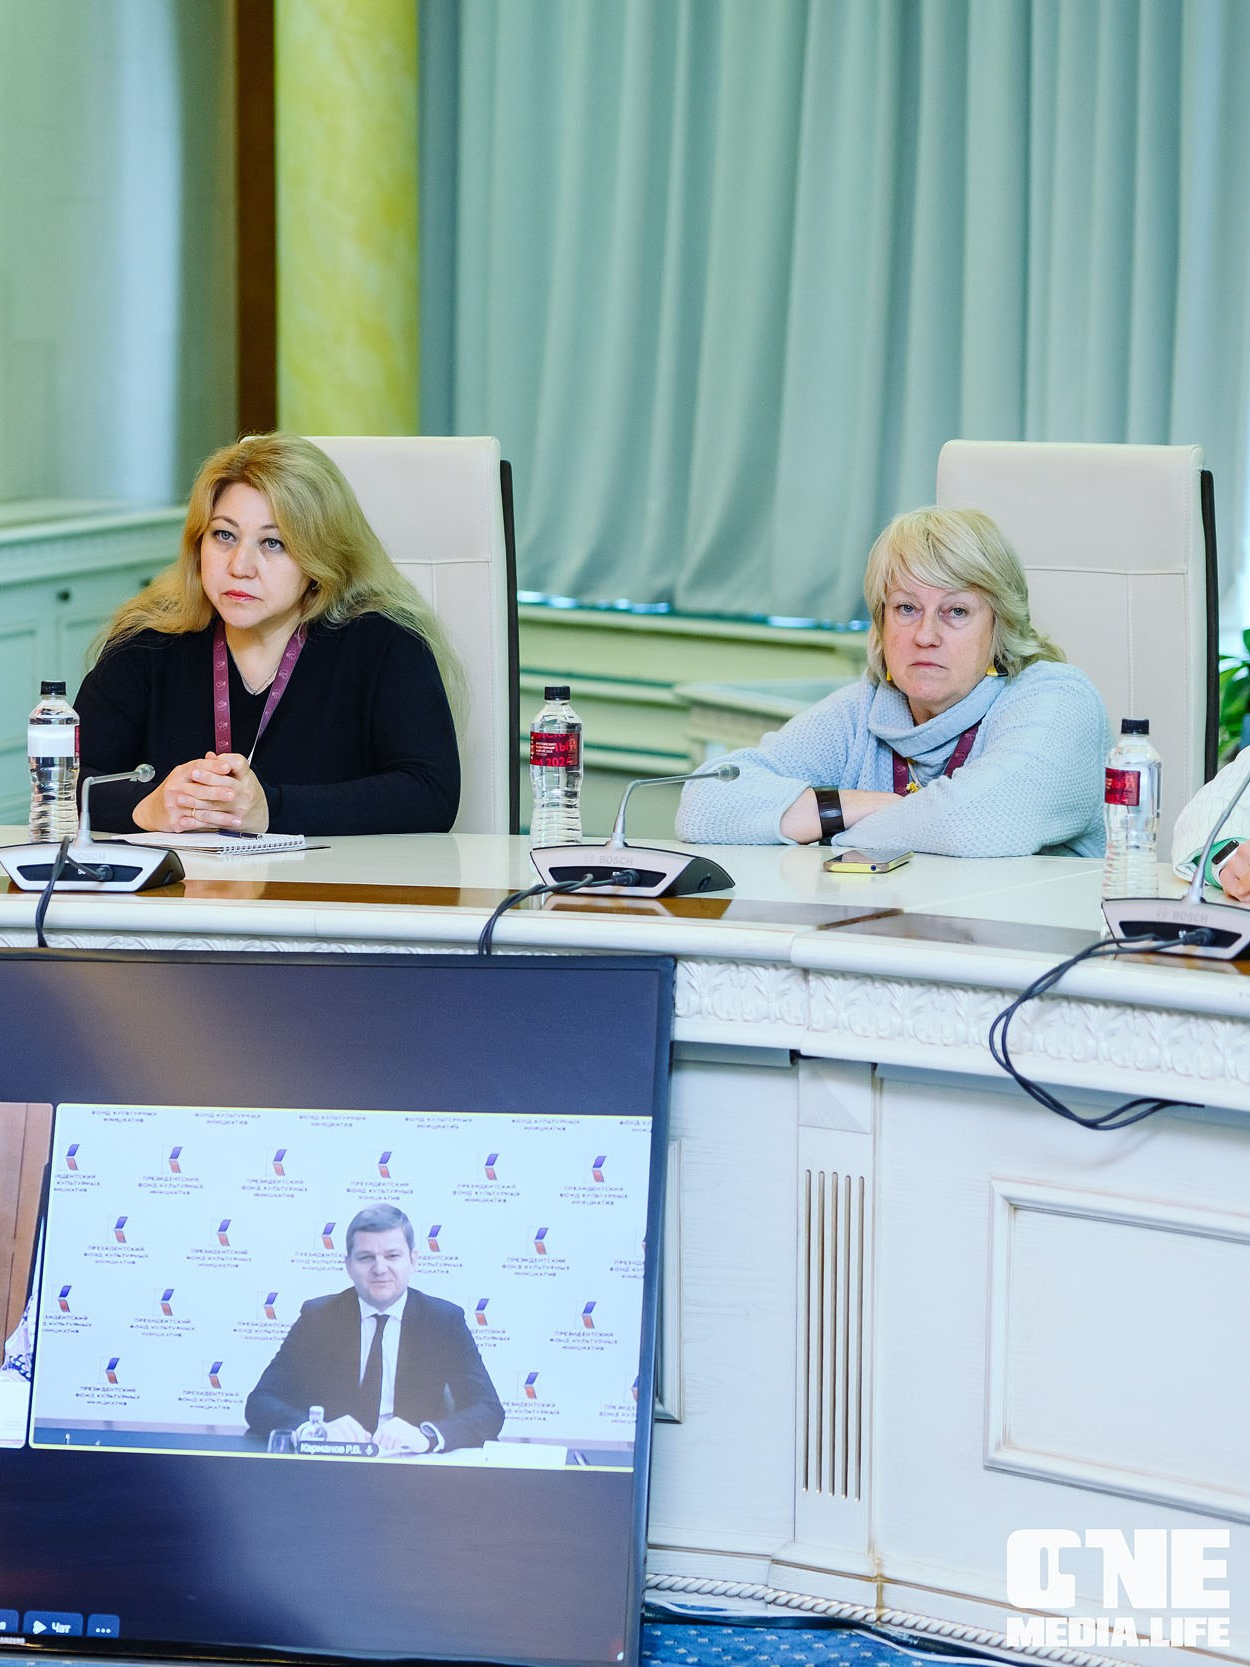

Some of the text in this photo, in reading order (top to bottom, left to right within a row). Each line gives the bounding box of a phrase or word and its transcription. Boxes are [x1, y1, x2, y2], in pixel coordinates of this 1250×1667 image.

[599, 855, 634, 866] BOSCH
[1172, 910, 1208, 925] BOSCH
[51, 1621, 71, 1634] Чат
